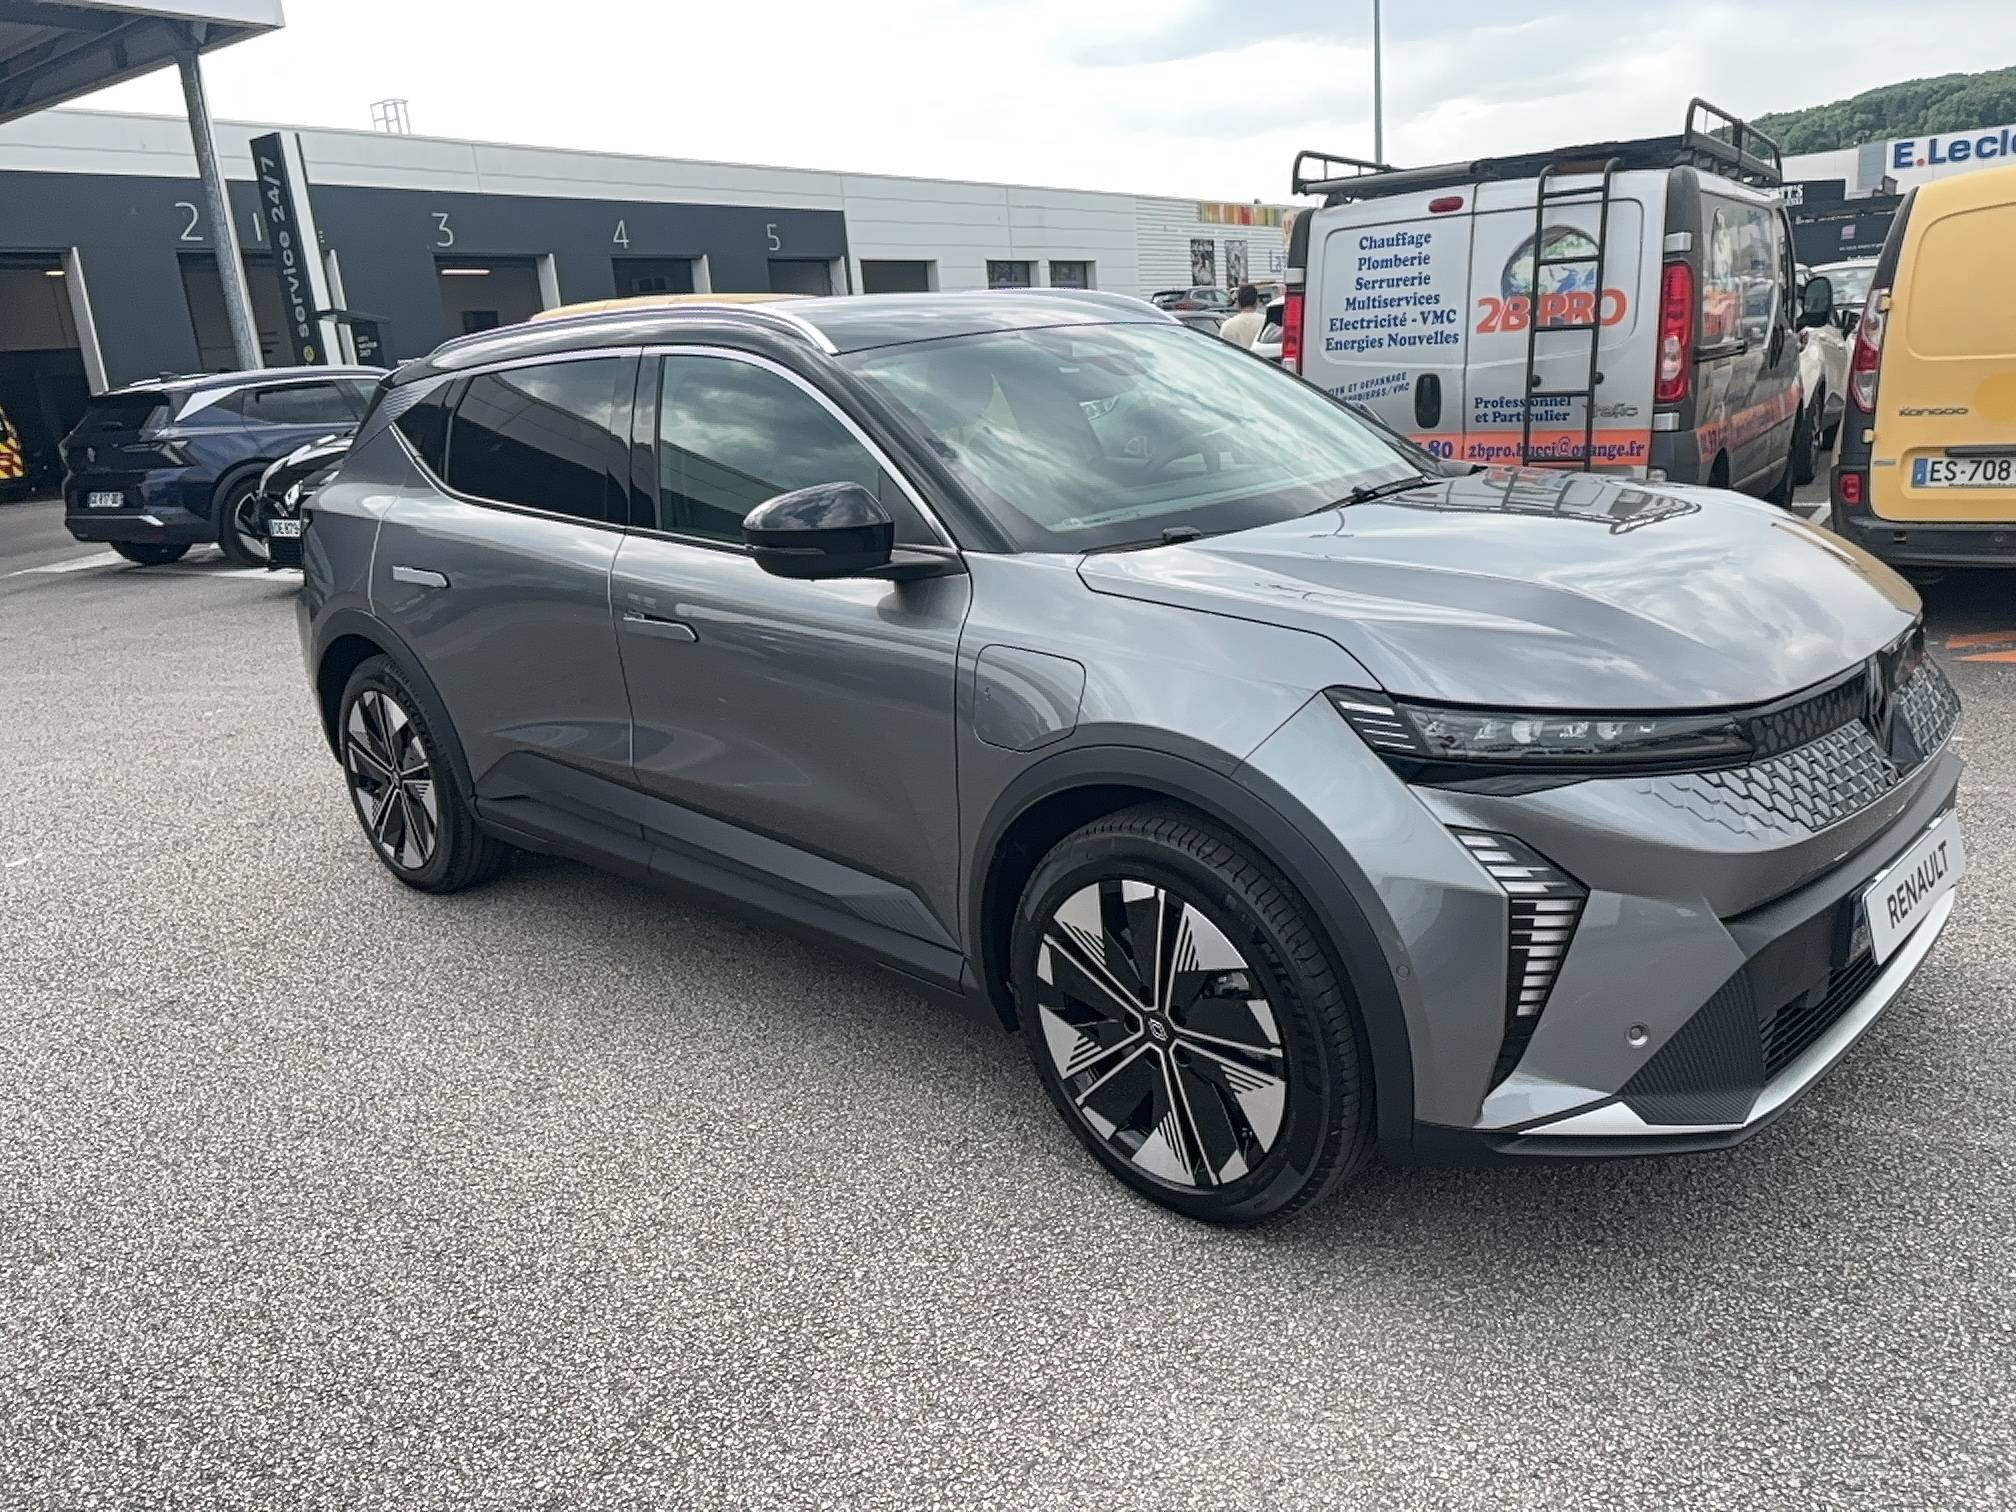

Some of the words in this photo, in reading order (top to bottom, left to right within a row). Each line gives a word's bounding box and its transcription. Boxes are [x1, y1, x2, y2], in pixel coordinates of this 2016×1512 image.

[1893, 128, 2016, 169] E.Lecl
[174, 202, 204, 241] 2
[431, 212, 454, 248] 3
[612, 219, 630, 249] 4
[766, 223, 781, 251] 5
[1359, 232, 1432, 250] Chauffage
[1357, 251, 1431, 271] Plomberie
[1355, 272, 1431, 291] Serrurerie
[1345, 292, 1440, 311] Multiservices
[1329, 312, 1407, 332] Electricité
[1420, 309, 1457, 326] VMC
[1325, 336, 1384, 352] Energies
[1387, 330, 1459, 348] Nouvelles
[1474, 396, 1572, 410] Professonnel
[1475, 412, 1489, 423] et
[1929, 459, 2016, 482] ES-708
[1886, 840, 1949, 929] RENAULT
